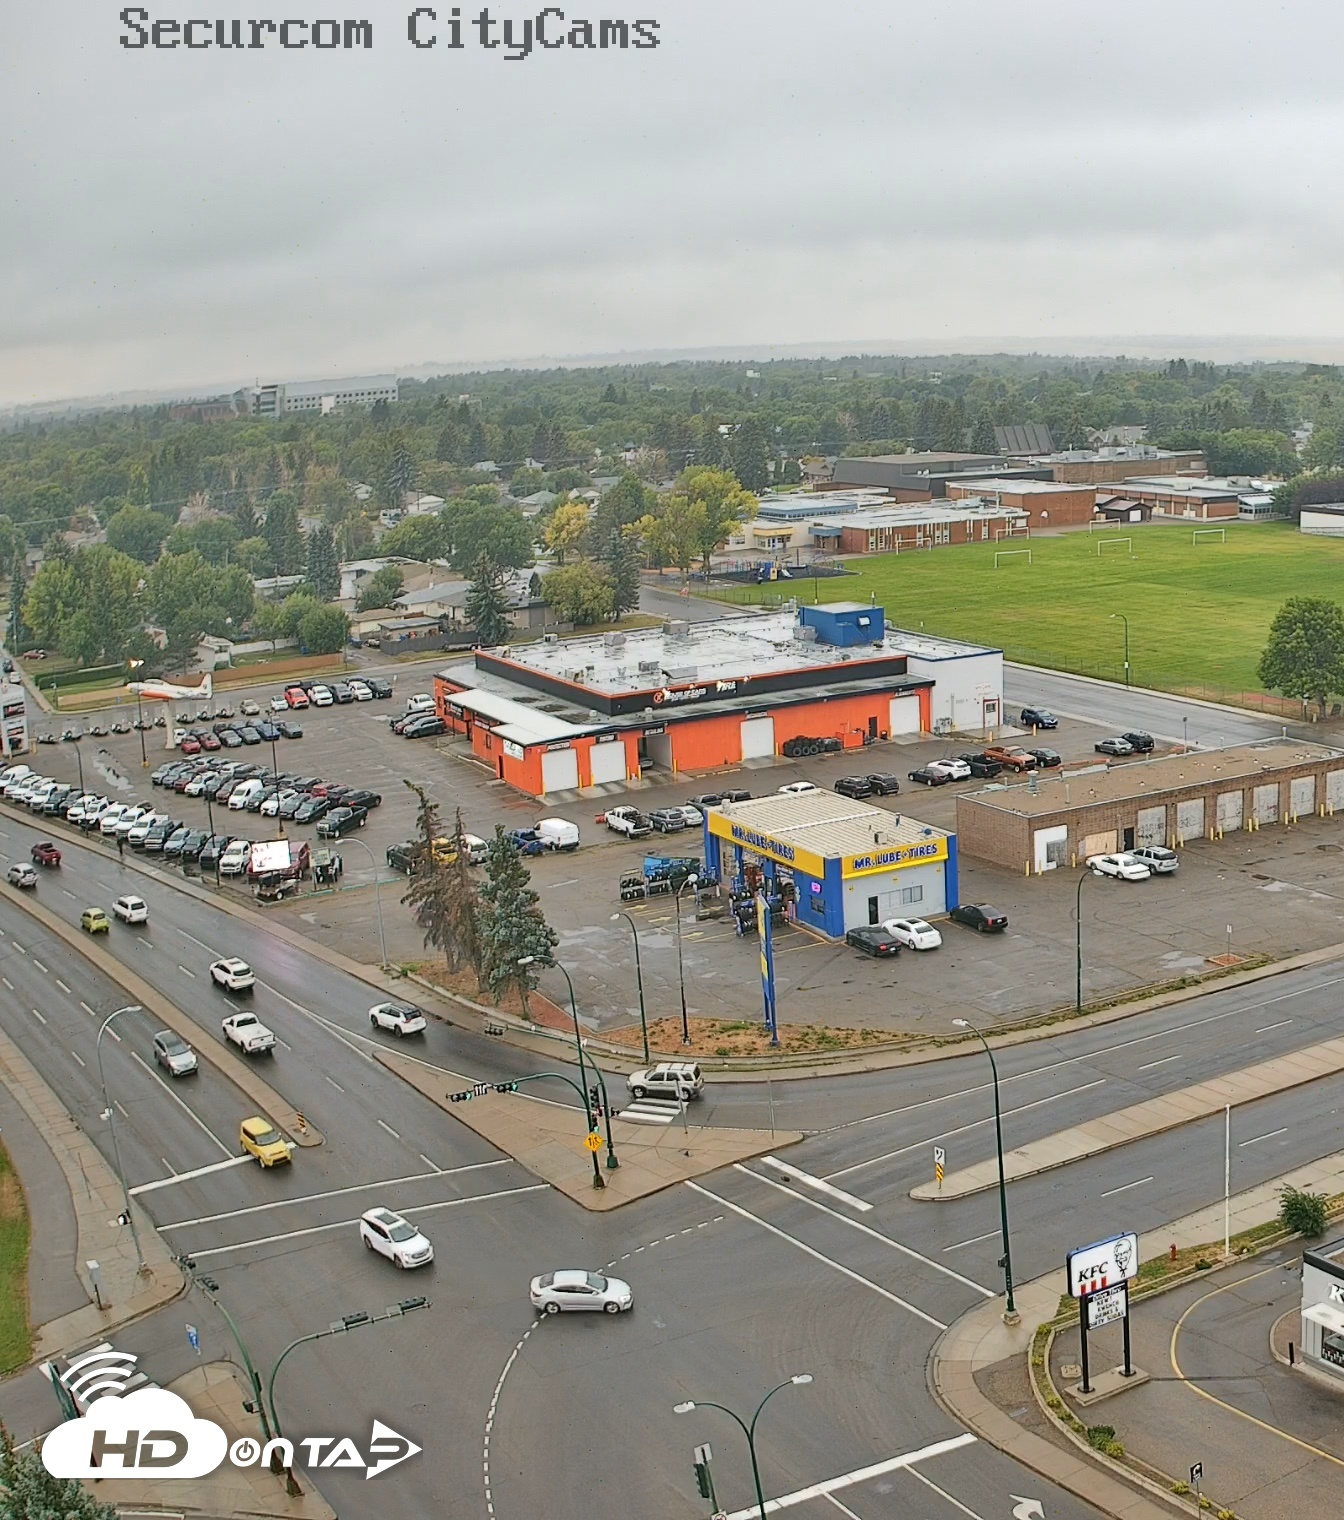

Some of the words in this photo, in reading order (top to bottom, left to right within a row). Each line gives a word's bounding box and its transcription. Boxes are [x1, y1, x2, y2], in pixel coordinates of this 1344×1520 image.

[731, 824, 748, 842] MR.
[747, 829, 768, 850] LUBE
[771, 840, 795, 862] TIRES
[853, 857, 876, 870] MR.
[876, 851, 901, 866] LUBE
[908, 844, 938, 857] TIRES
[1078, 1261, 1109, 1283] KFC
